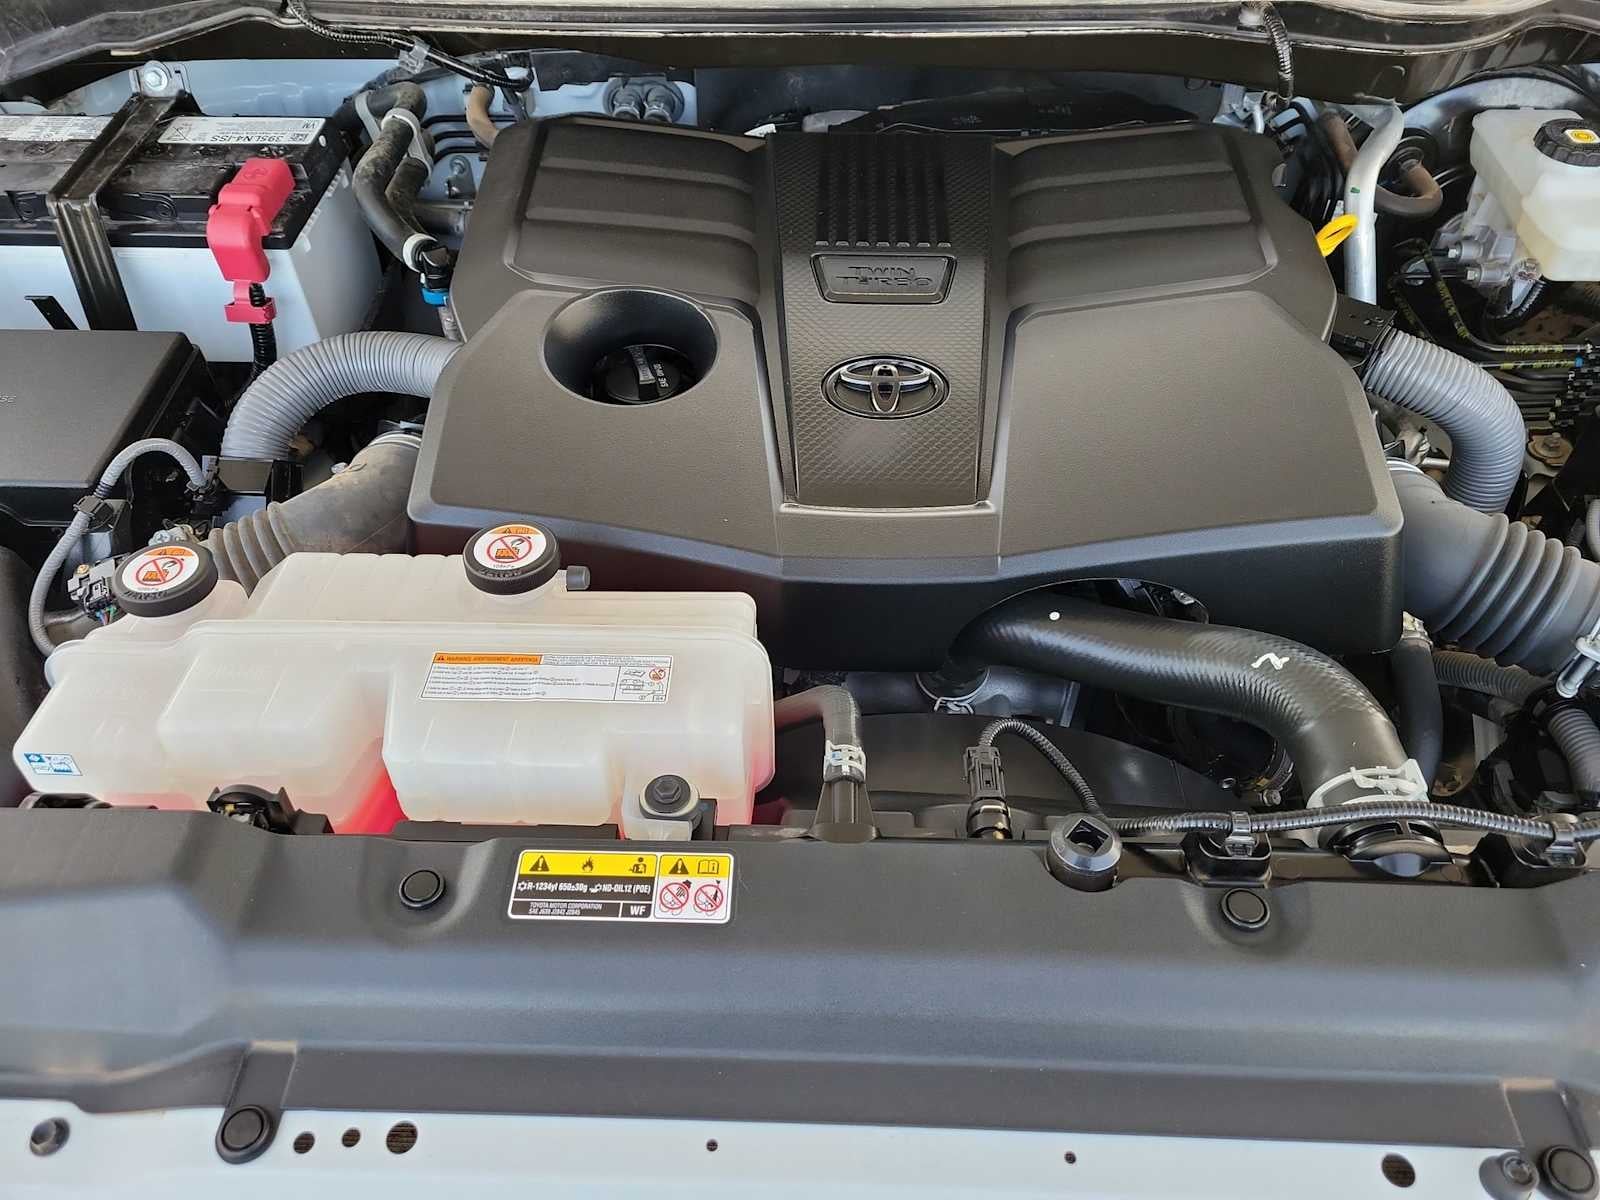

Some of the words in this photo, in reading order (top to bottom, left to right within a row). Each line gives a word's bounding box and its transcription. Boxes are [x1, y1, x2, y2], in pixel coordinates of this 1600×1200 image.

[848, 266, 915, 276] TWIN
[836, 276, 934, 286] TURBO
[630, 905, 646, 915] WF
